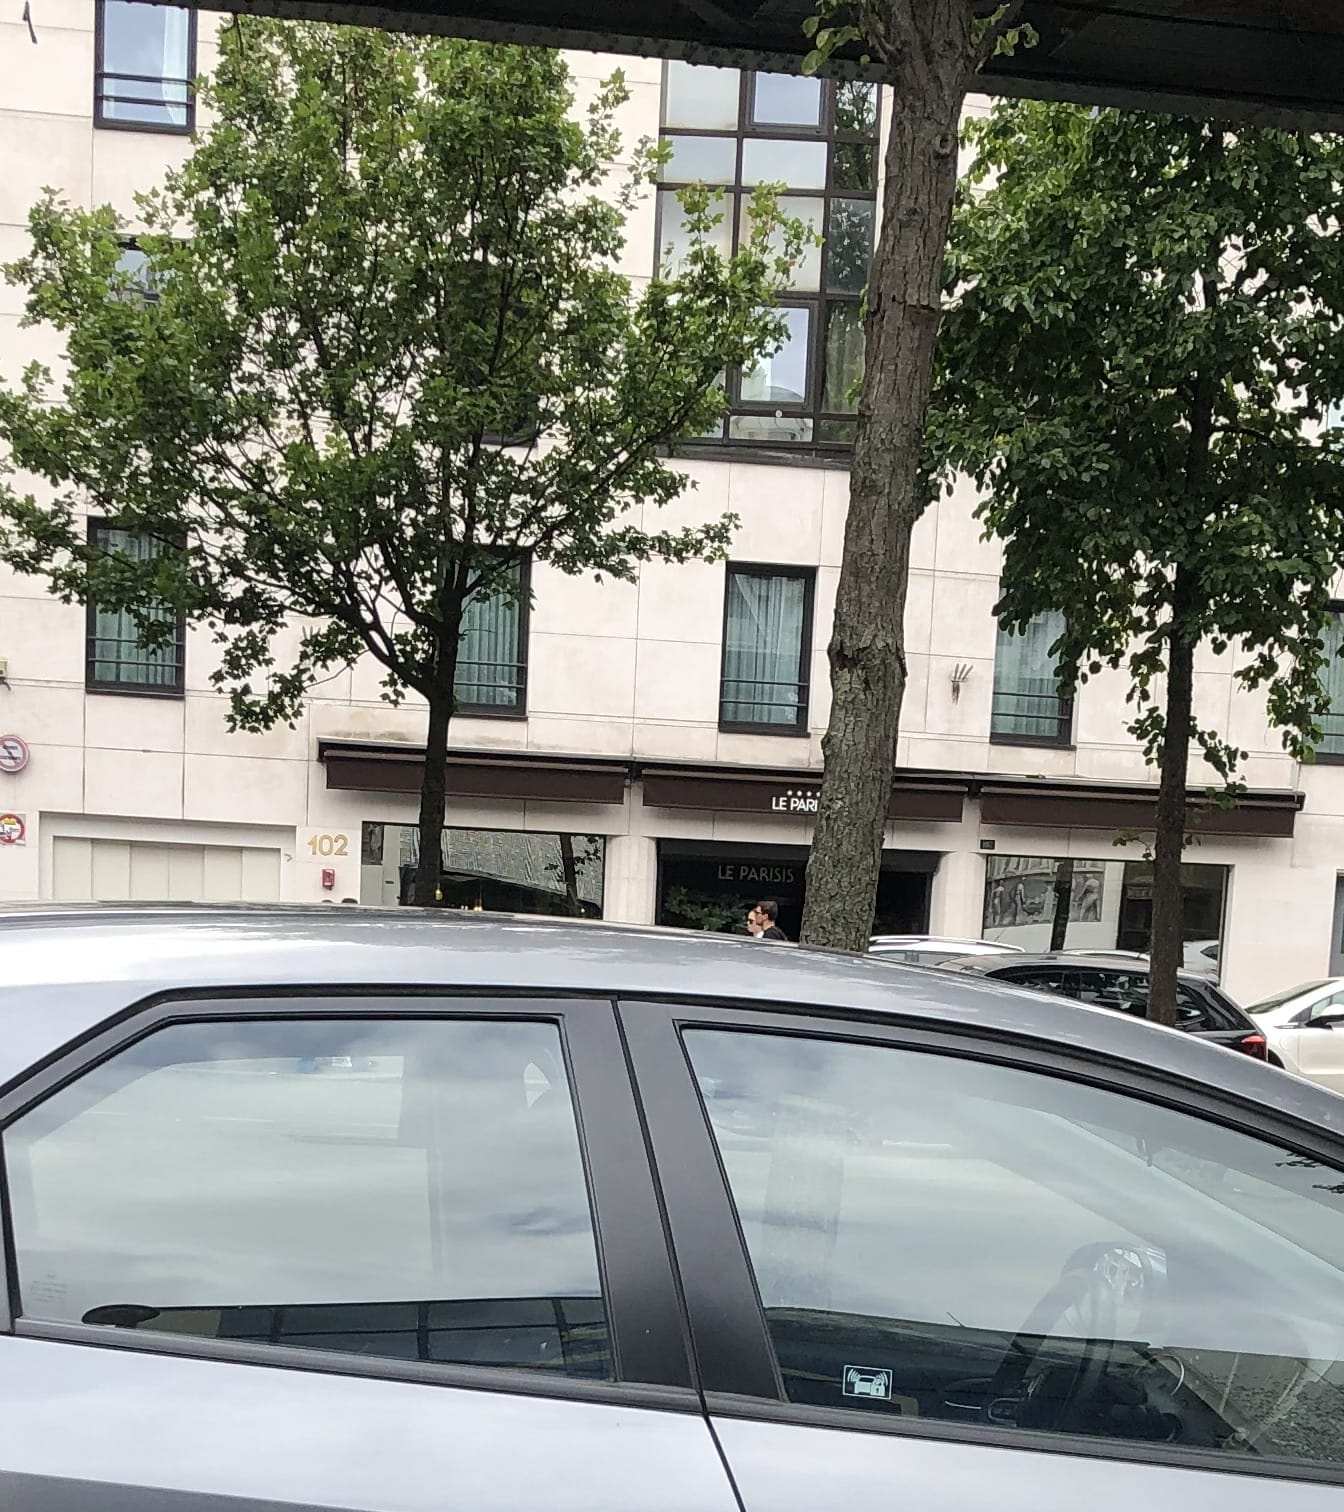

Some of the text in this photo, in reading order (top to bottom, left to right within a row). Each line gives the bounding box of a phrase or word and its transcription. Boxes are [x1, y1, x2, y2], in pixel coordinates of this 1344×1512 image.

[772, 796, 818, 812] LE PARI
[307, 834, 349, 856] 102
[718, 865, 794, 883] LE PARISIS
